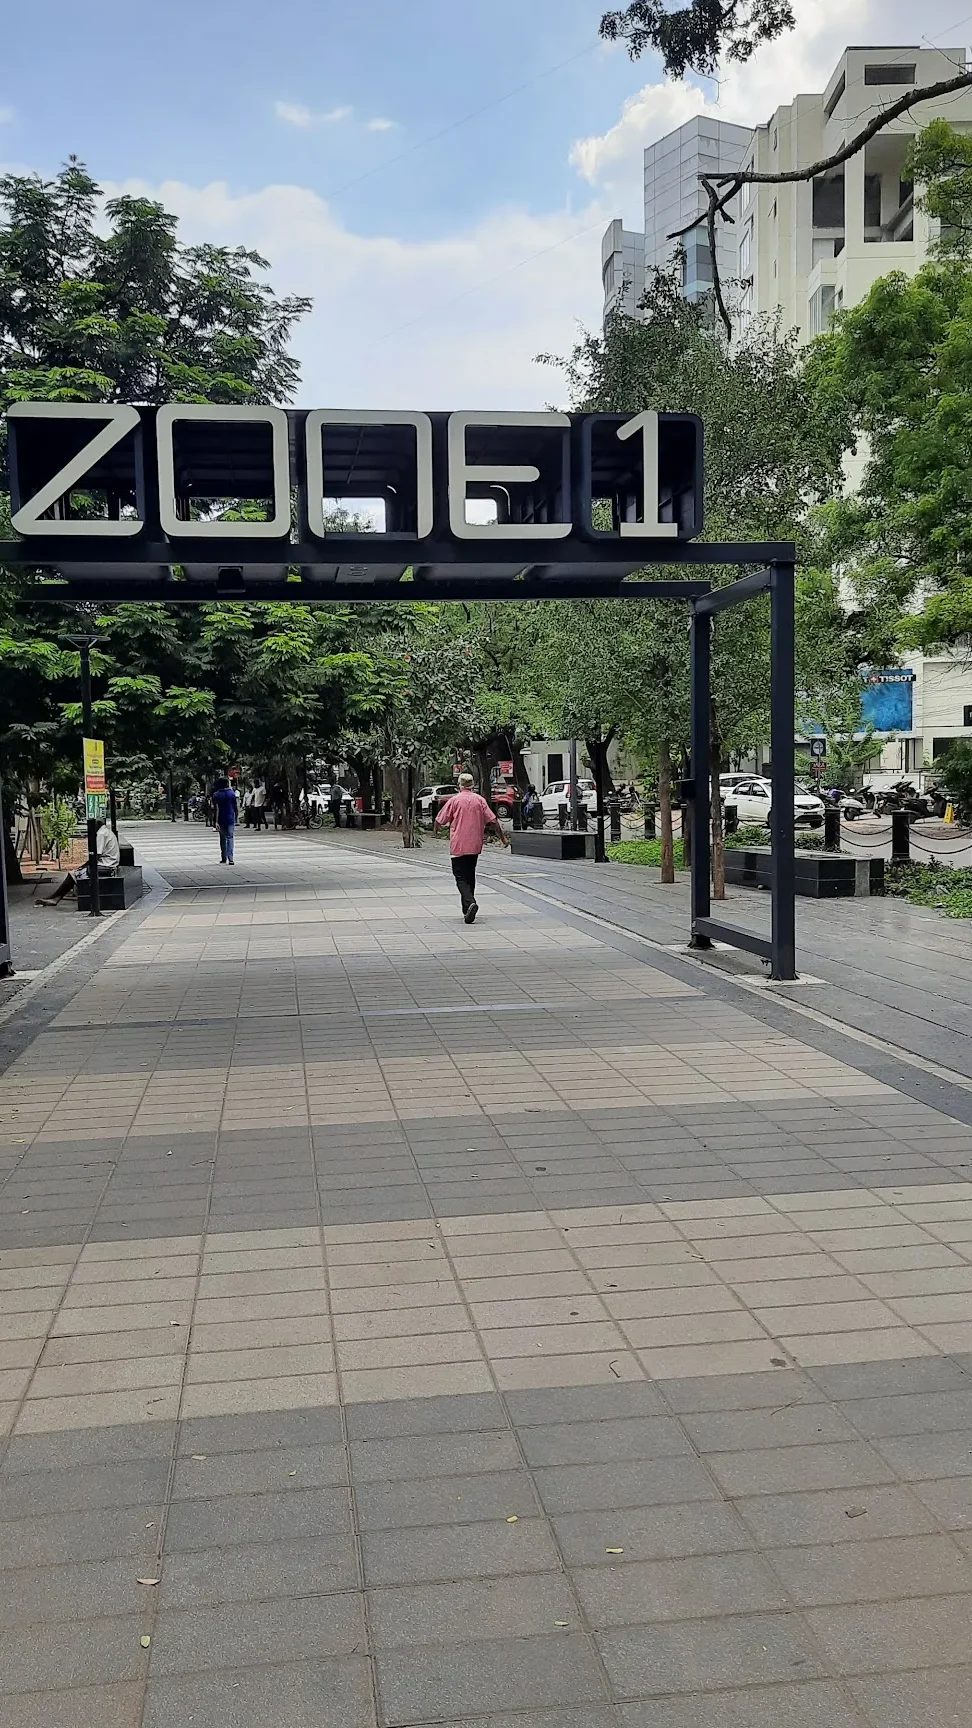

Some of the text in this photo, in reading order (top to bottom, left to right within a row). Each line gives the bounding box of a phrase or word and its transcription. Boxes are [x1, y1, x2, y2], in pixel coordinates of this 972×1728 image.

[7, 403, 679, 540] ZONE 1
[879, 674, 914, 682] TISSOT
